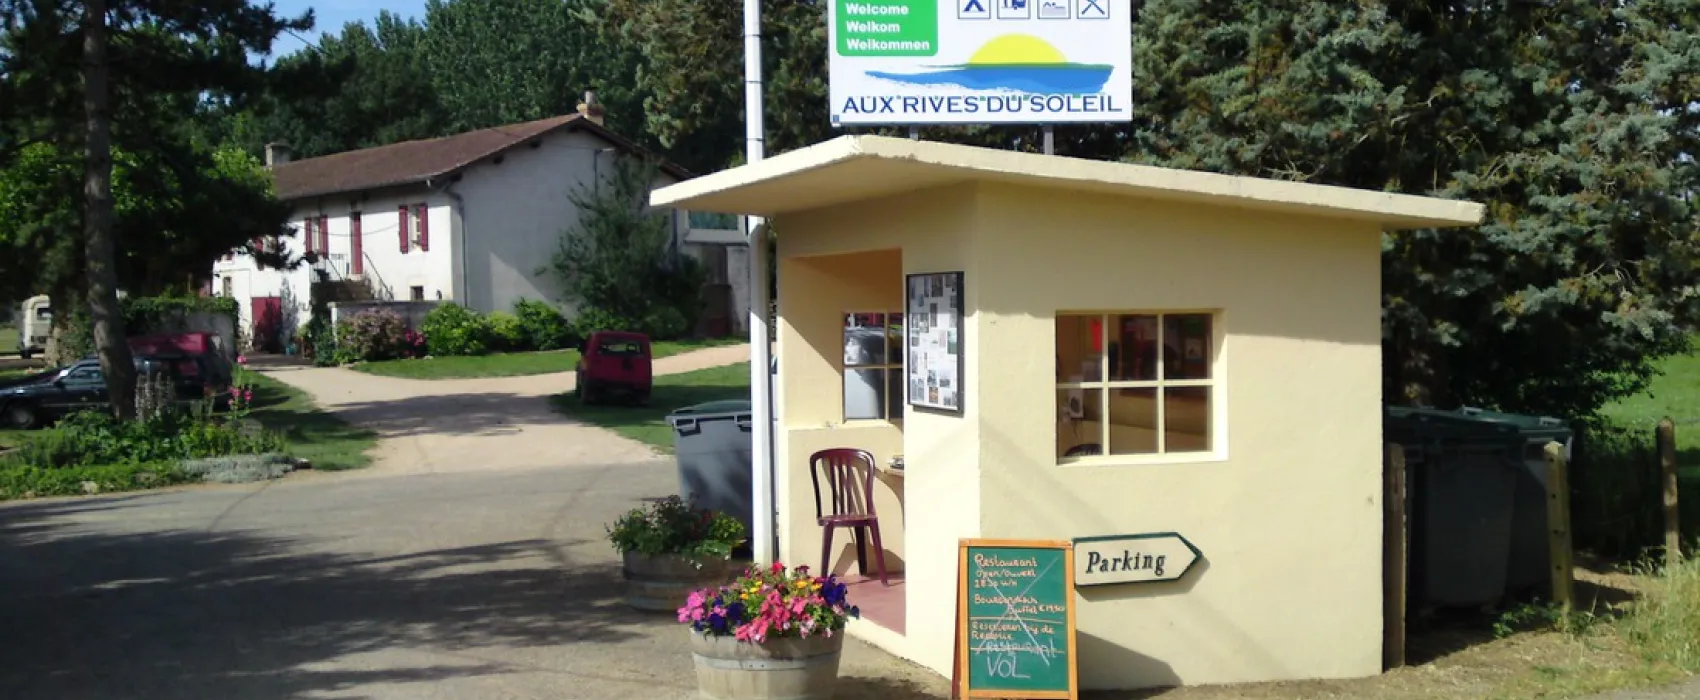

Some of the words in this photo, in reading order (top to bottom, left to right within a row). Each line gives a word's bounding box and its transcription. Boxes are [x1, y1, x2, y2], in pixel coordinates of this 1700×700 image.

[845, 3, 909, 15] Welcome
[846, 20, 901, 33] Welkom
[842, 95, 894, 114] AUX
[902, 95, 979, 114] RIVES
[986, 95, 1024, 113] DU
[1029, 95, 1123, 113] SOLEIL
[1085, 550, 1166, 577] Parking
[986, 652, 1031, 678] VOL
